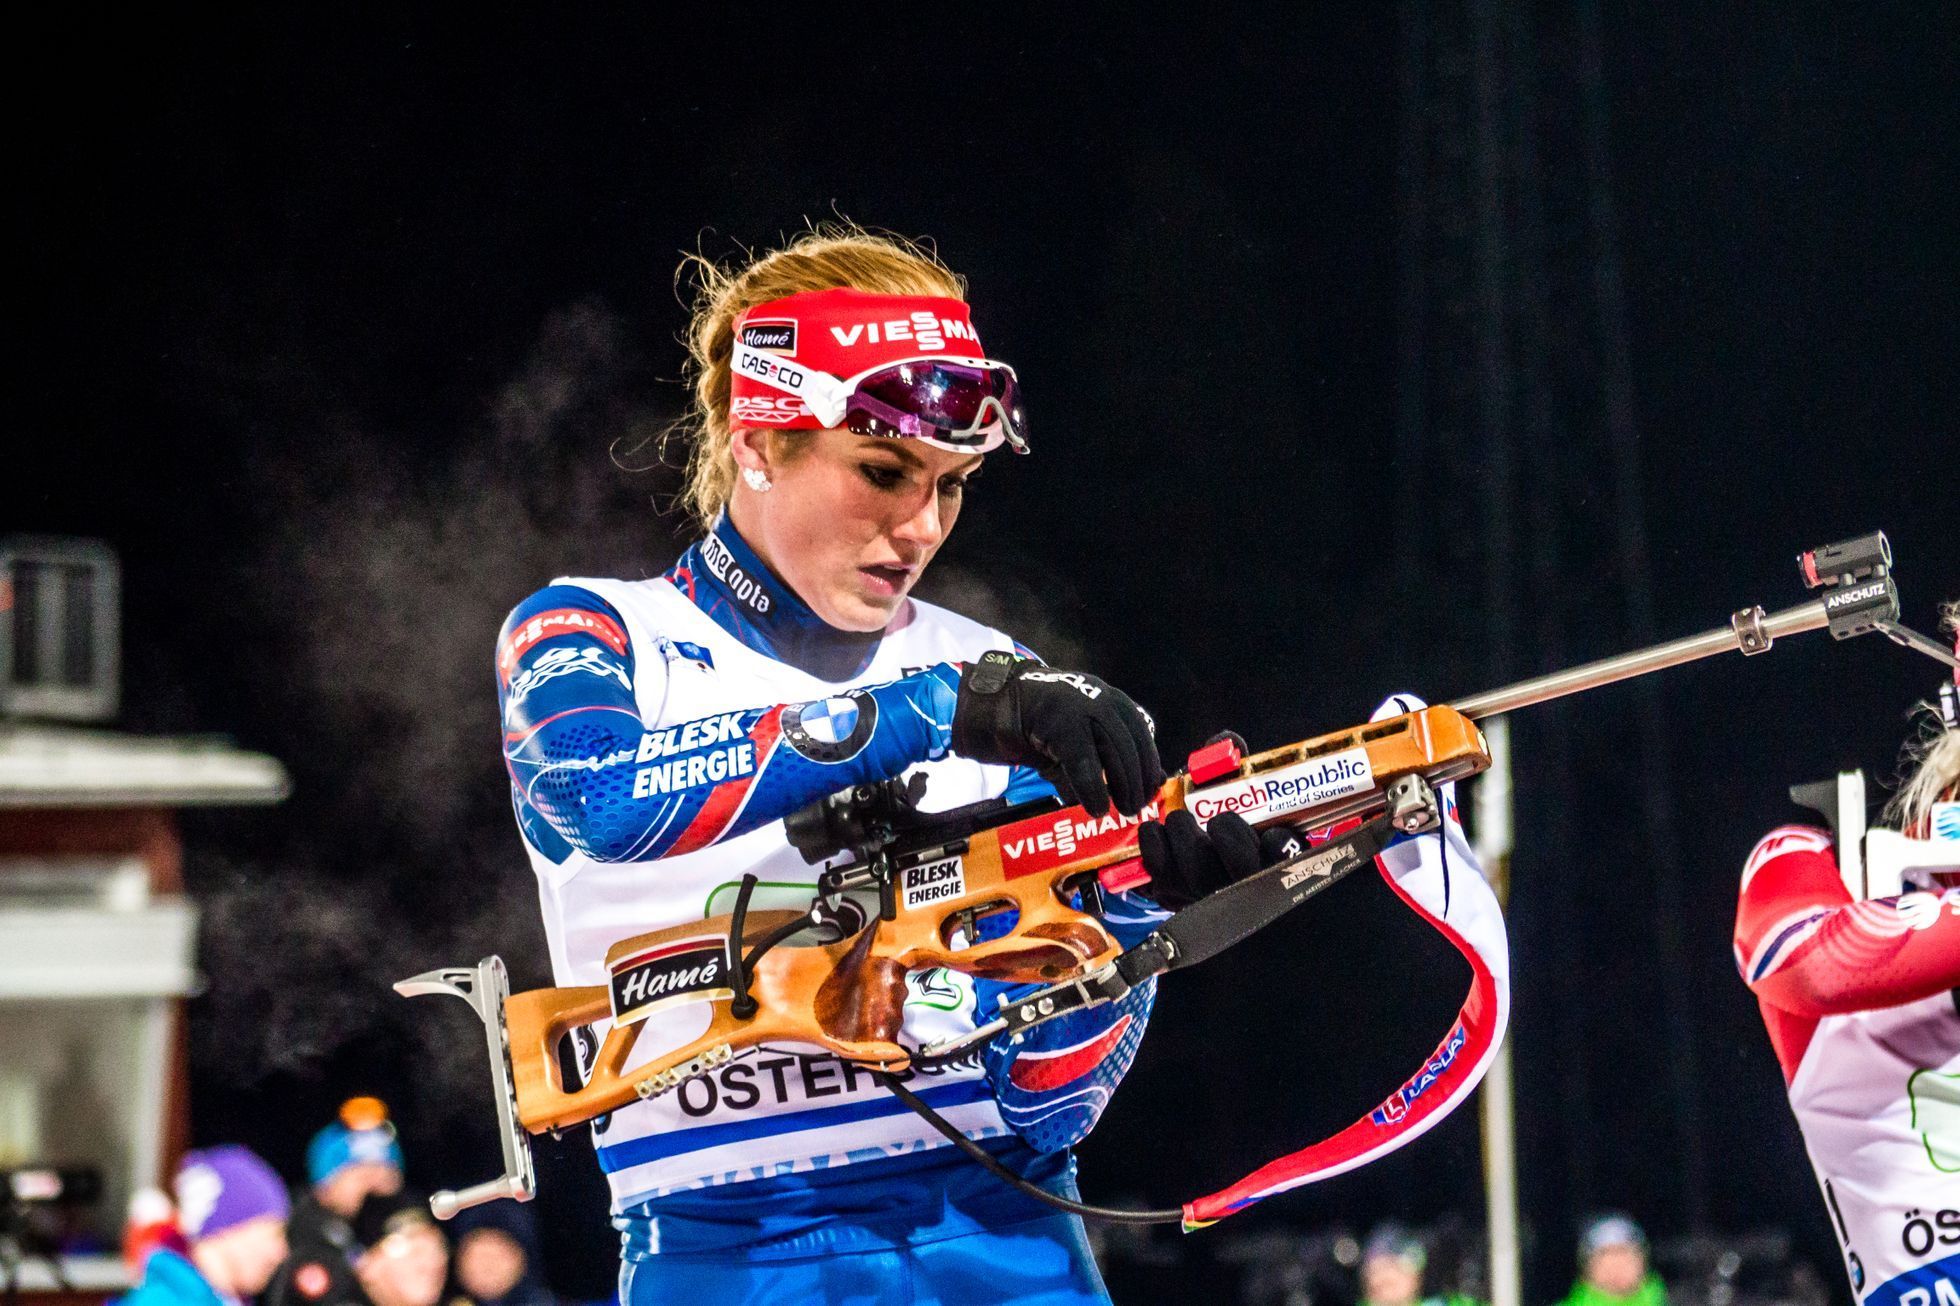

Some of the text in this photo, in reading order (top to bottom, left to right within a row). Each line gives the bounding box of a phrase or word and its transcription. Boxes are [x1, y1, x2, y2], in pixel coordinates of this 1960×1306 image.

[744, 329, 790, 347] Hamé
[635, 711, 747, 764] BLESK
[632, 743, 753, 800] ENERGIE
[1312, 785, 1355, 801] Stories
[906, 860, 959, 889] BLESK
[908, 880, 962, 905] ENERGIE
[622, 957, 719, 1006] Hamé
